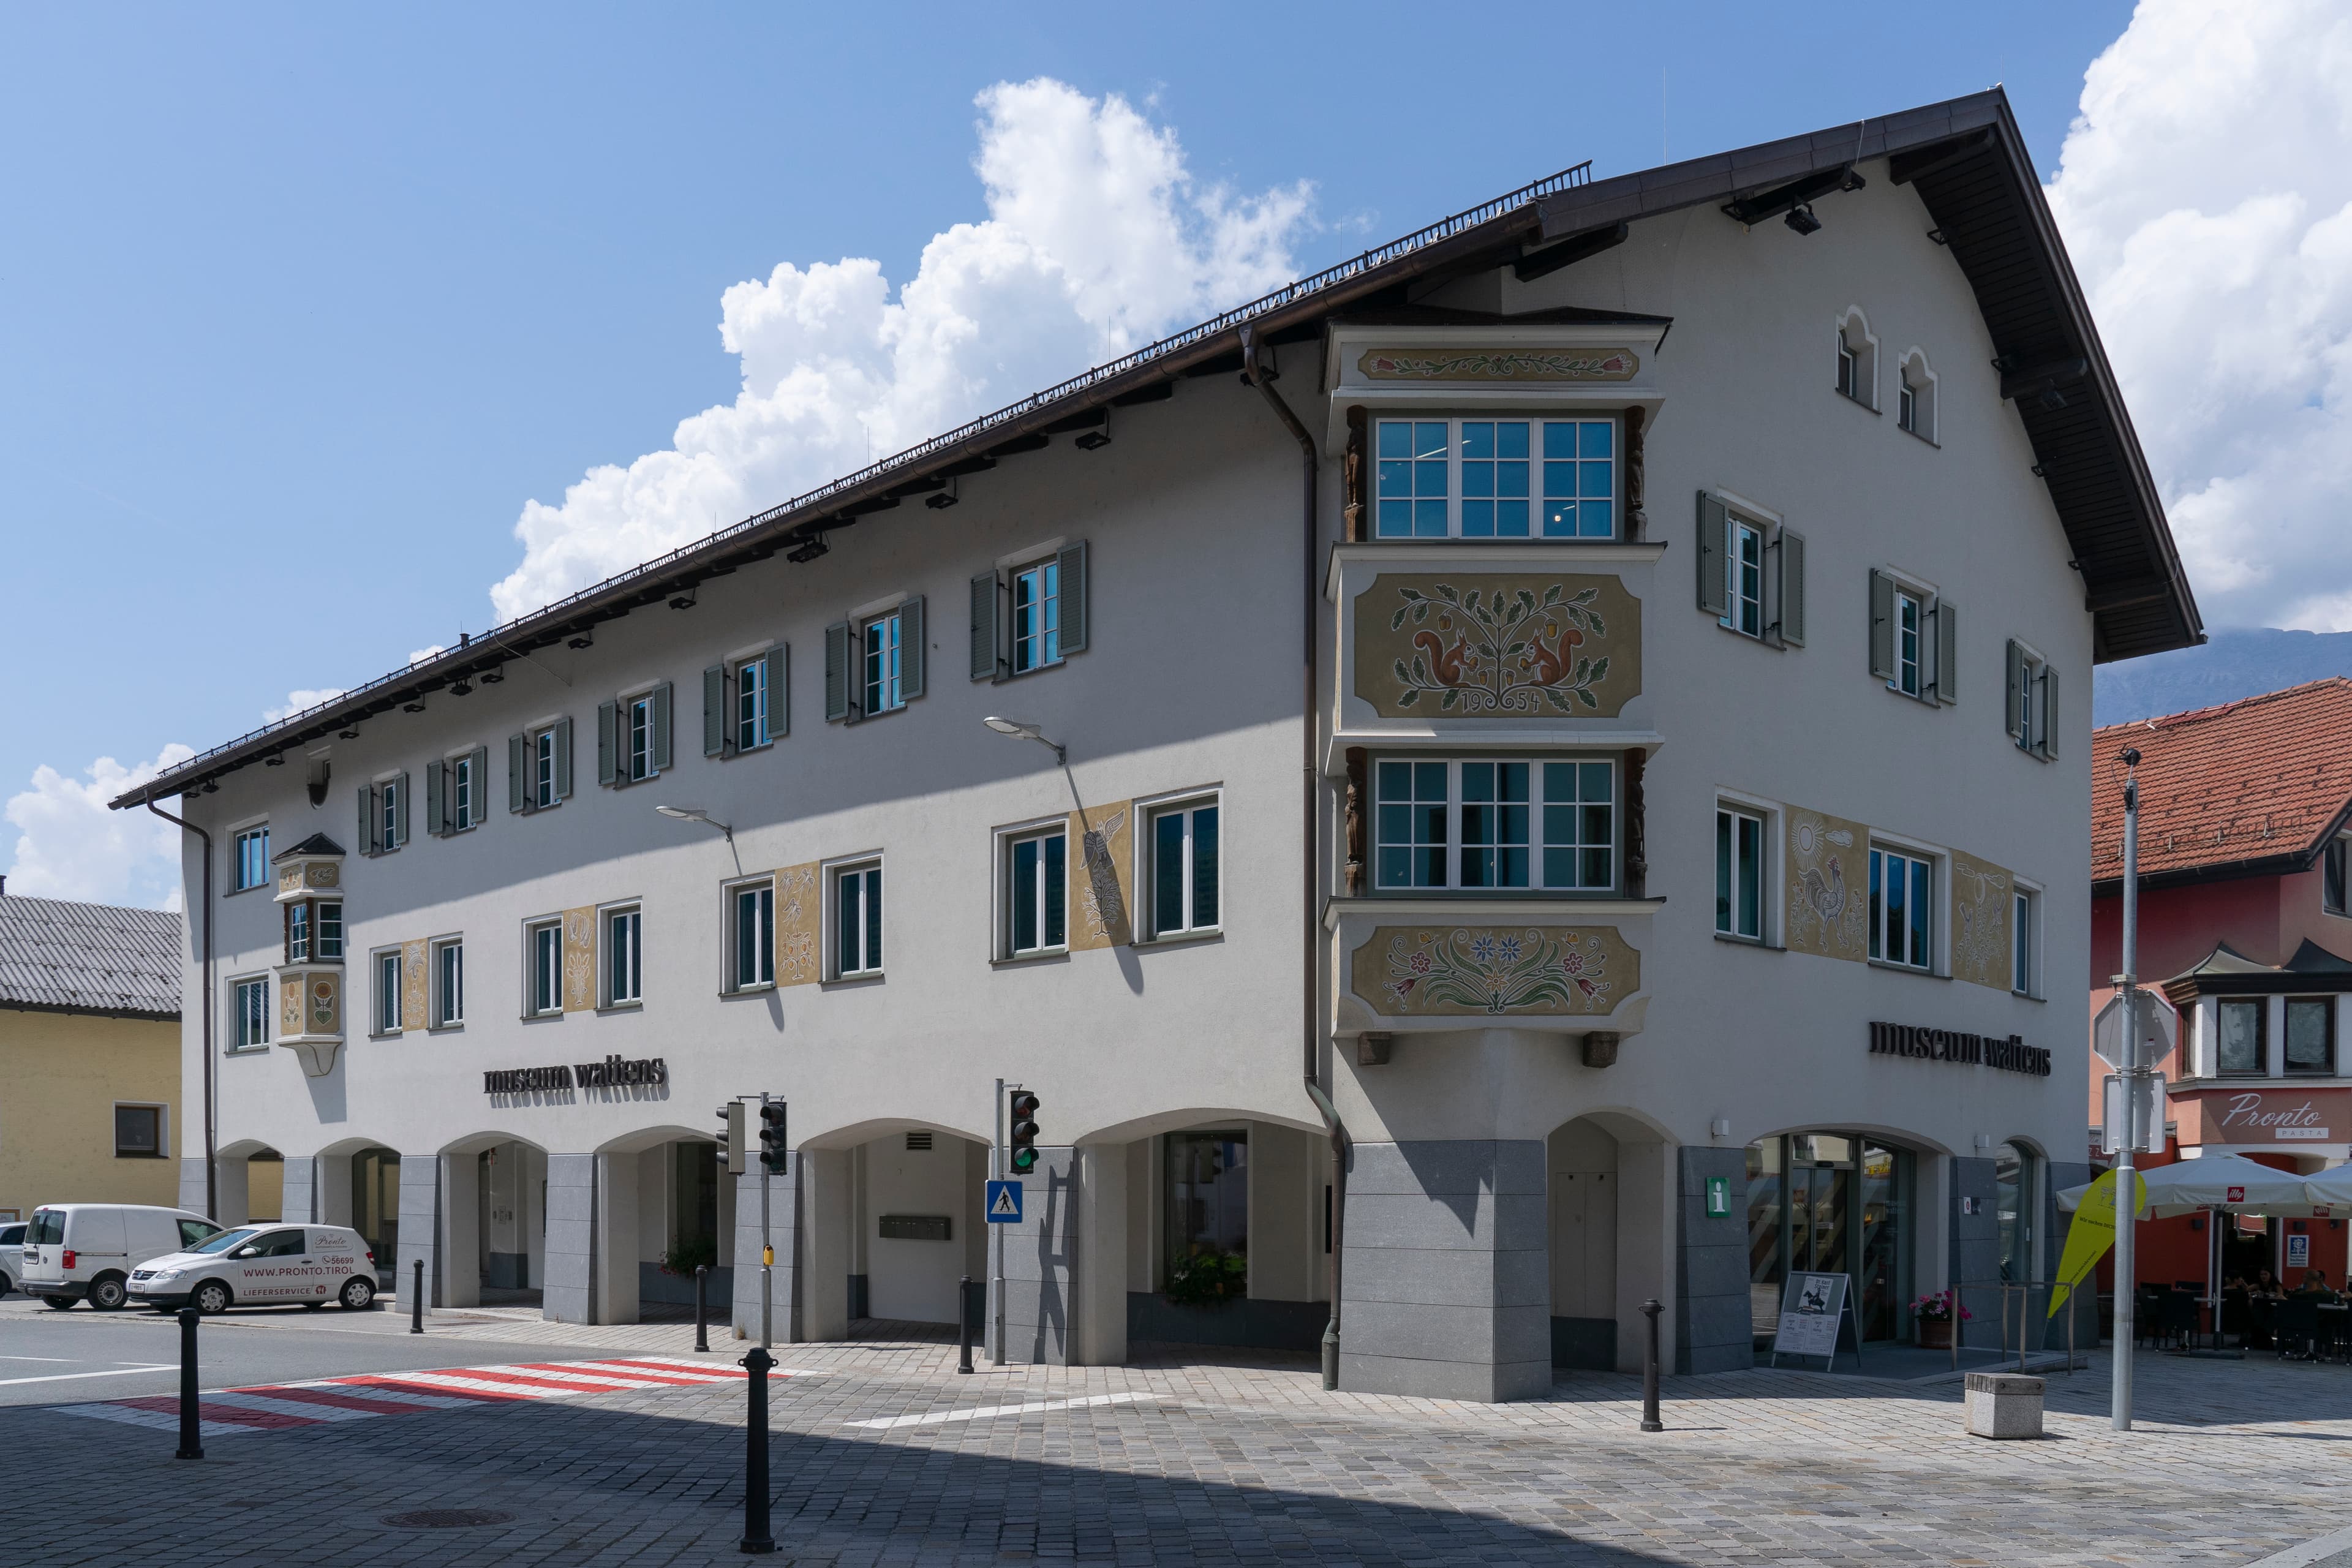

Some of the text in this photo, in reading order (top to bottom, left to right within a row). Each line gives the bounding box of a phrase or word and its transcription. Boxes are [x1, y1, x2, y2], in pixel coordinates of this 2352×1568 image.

[1461, 692, 1541, 713] 19 54
[1869, 1021, 2051, 1076] museum wattens
[483, 1054, 665, 1093] museum wattens
[2222, 1093, 2322, 1126] Pronto
[2229, 1188, 2243, 1200] illy
[315, 1235, 347, 1245] Pronto
[244, 1266, 355, 1277] WWW.PRONTO.TIROL
[244, 1287, 311, 1296] LIEFERSERVICE
